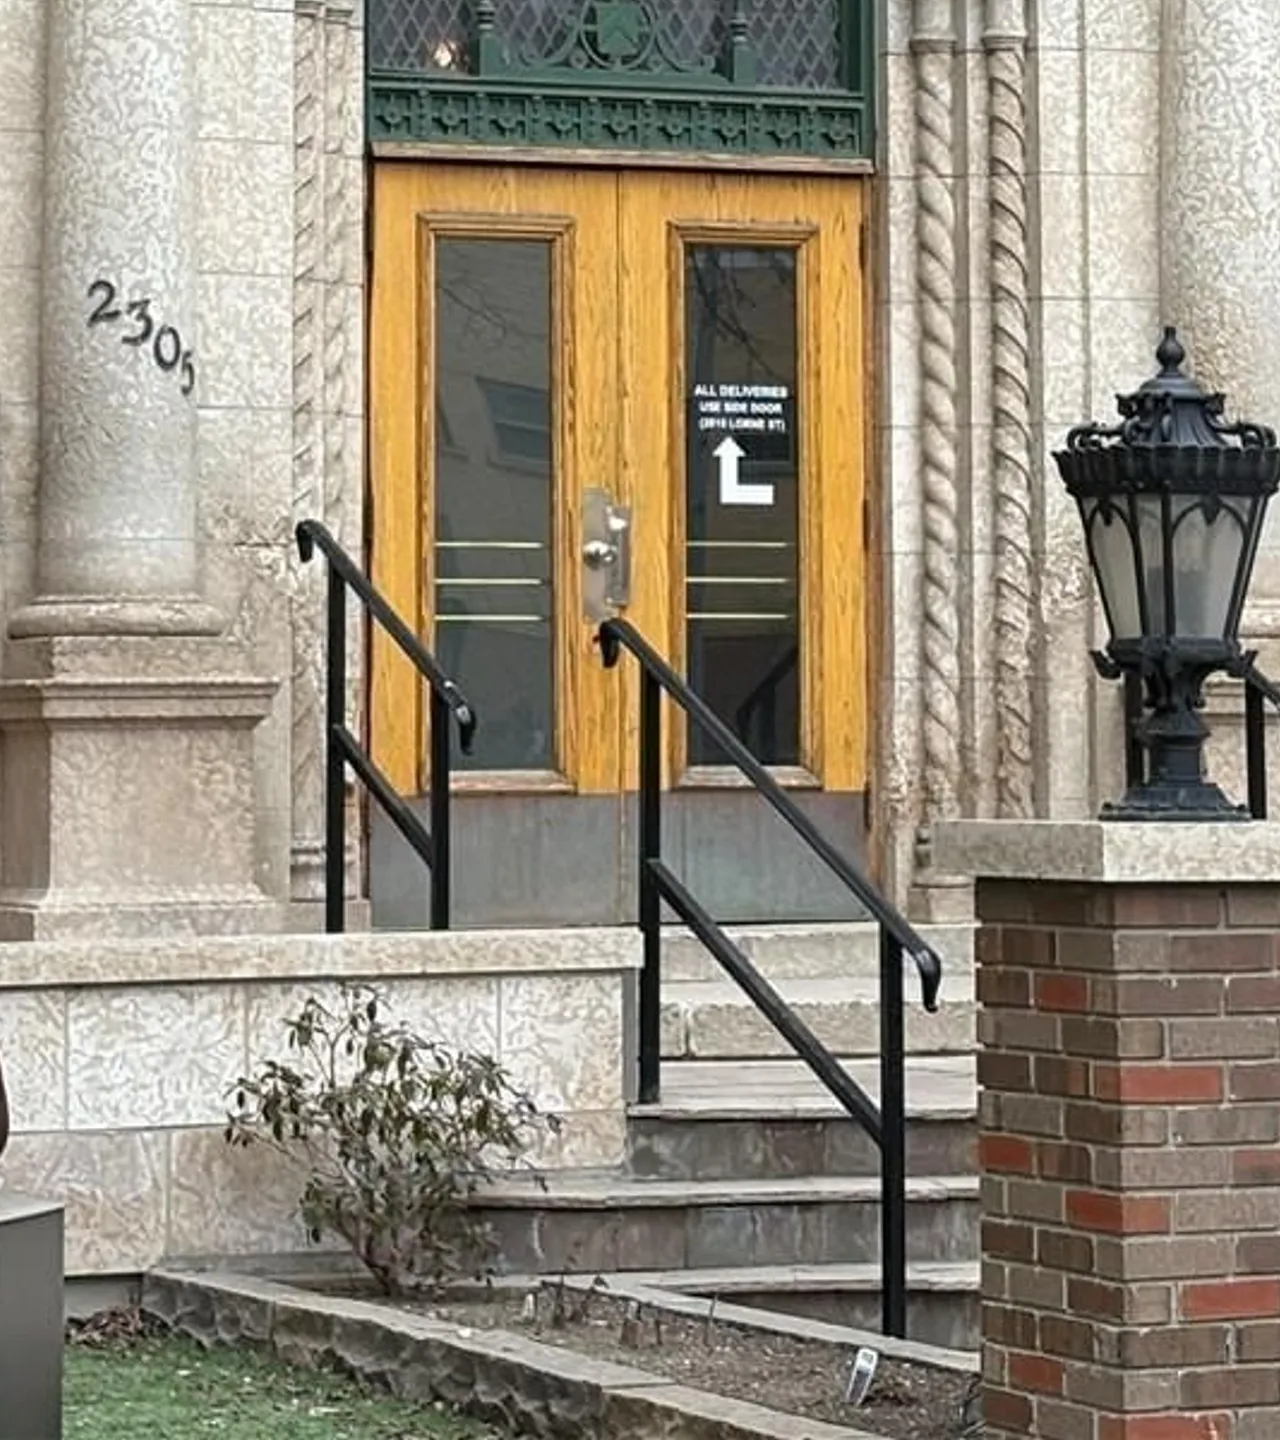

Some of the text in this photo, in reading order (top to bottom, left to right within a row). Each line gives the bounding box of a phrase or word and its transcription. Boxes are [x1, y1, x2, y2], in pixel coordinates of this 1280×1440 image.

[87, 280, 195, 396] 2305
[694, 383, 718, 397] ALL
[699, 401, 721, 413] USE
[750, 402, 783, 415] DOOR
